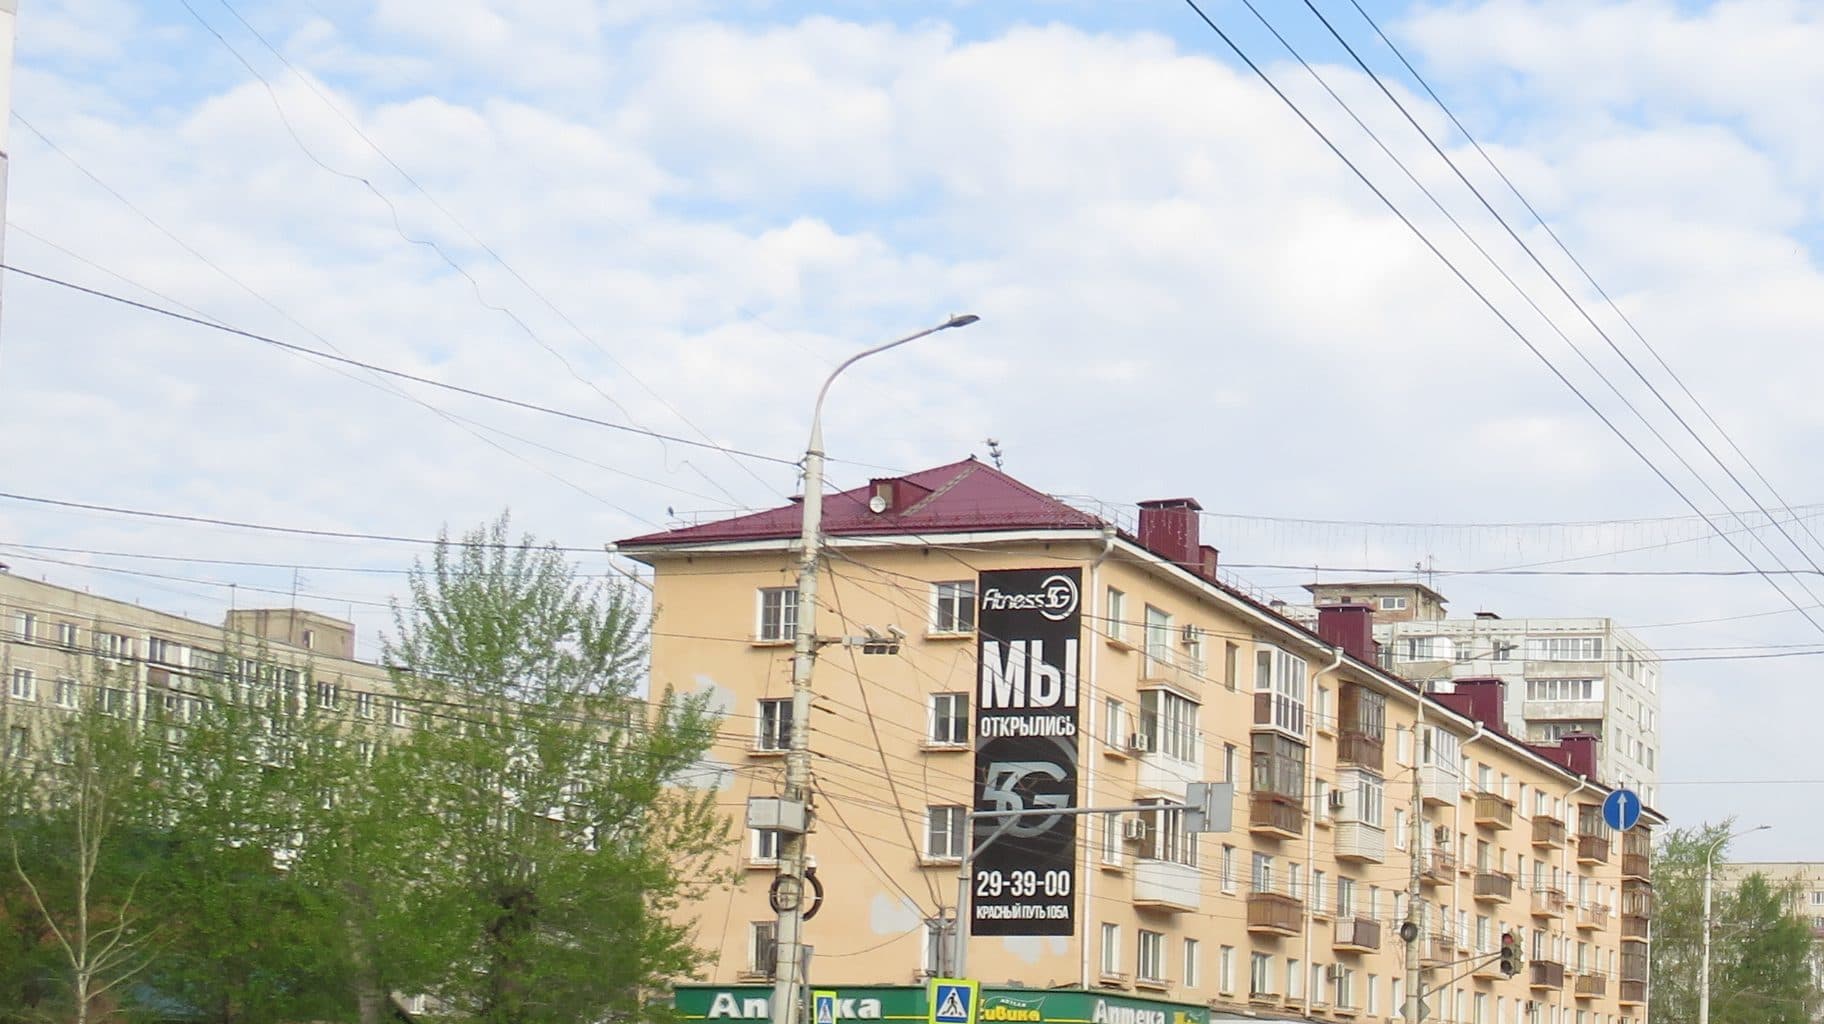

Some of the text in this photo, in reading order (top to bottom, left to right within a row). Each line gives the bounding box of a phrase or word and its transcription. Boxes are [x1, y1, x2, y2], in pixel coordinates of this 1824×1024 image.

[981, 638, 1078, 710] МЫ
[980, 715, 1076, 737] ОТКРЫЛИСЬ
[976, 870, 1071, 897] 29-39-00
[976, 903, 1022, 919] КРАСНЫЙ
[1022, 905, 1047, 919] ПУТЬ
[708, 992, 882, 1019] Апка
